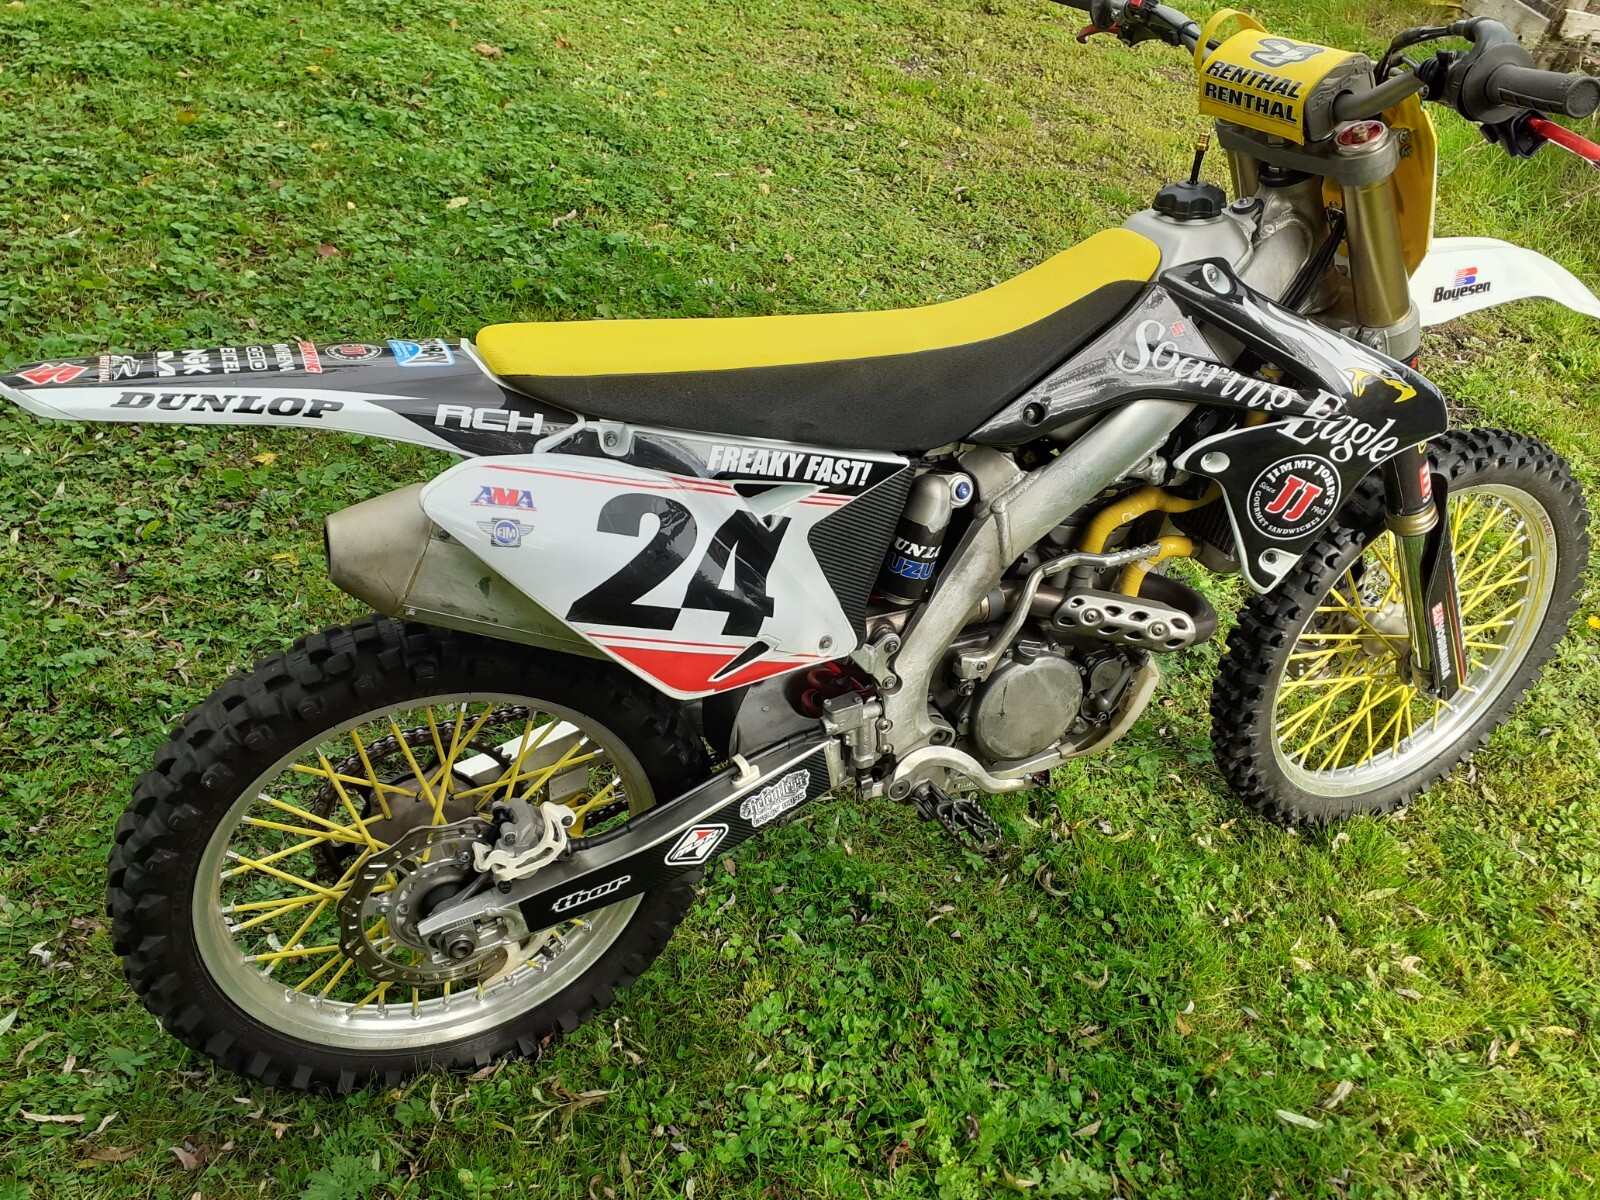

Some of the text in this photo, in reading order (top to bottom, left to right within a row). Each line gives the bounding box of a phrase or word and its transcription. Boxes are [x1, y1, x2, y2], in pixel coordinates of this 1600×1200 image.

[1204, 60, 1303, 100] RENTHAL
[1204, 81, 1298, 124] RENTHAL
[1432, 280, 1492, 304] Boyesen
[181, 348, 213, 375] NGK
[109, 390, 345, 419] DUNLOP
[434, 403, 544, 436] RCH
[1276, 387, 1399, 463] Eagle
[705, 444, 874, 487] FREAKY FAST!
[1265, 459, 1337, 508] JIMMY JOHN'S
[470, 485, 537, 510] AMA
[1258, 481, 1277, 494] Since
[1264, 473, 1324, 522] JJ
[496, 526, 517, 539] FIM
[1253, 490, 1322, 536] GOURMET SANDWICHES
[566, 493, 792, 638] 24
[549, 874, 632, 913] thor
